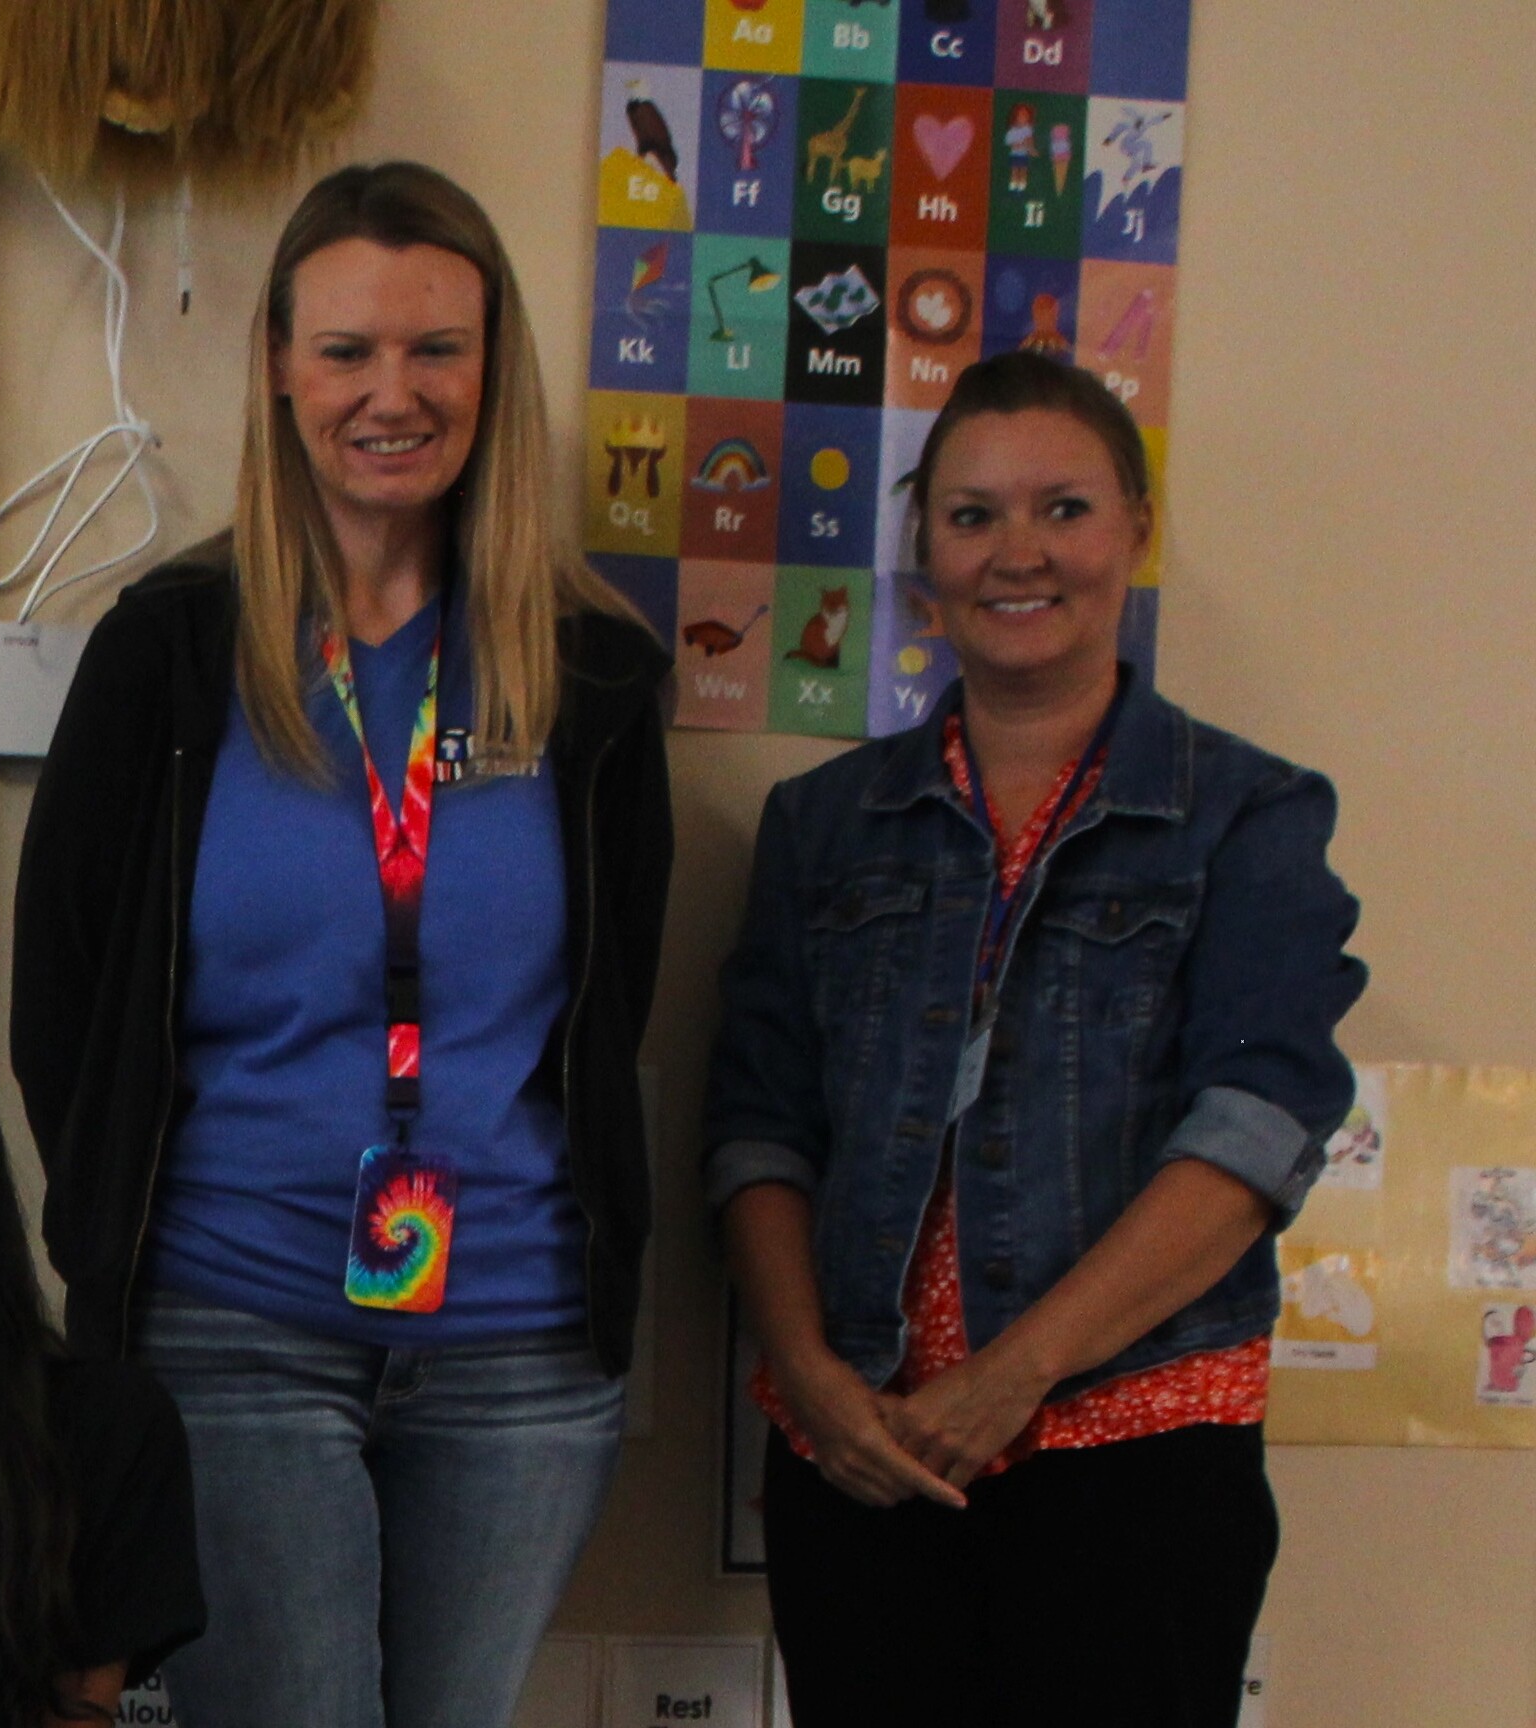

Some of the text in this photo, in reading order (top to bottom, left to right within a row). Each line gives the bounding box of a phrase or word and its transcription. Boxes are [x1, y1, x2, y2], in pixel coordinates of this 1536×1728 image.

[733, 19, 773, 45] Aa
[833, 24, 869, 50] Bb
[931, 32, 964, 59] Cc
[1024, 39, 1064, 66] Dd
[628, 177, 659, 203] Ee
[733, 181, 760, 207] Ff
[822, 189, 861, 222] Gg
[918, 196, 957, 222] Hh
[1026, 202, 1044, 228] Ii
[1123, 210, 1145, 242] Jj
[619, 338, 654, 365] Kk
[728, 344, 751, 370] Ll
[808, 349, 861, 376] Mm
[911, 356, 949, 383] Nn
[609, 500, 654, 536] Qq
[715, 506, 745, 533] Rr
[811, 512, 839, 538] Ss
[694, 673, 746, 701] Ww
[798, 678, 835, 705] Xx
[895, 686, 926, 717] Yy
[656, 1693, 712, 1720] Rest
